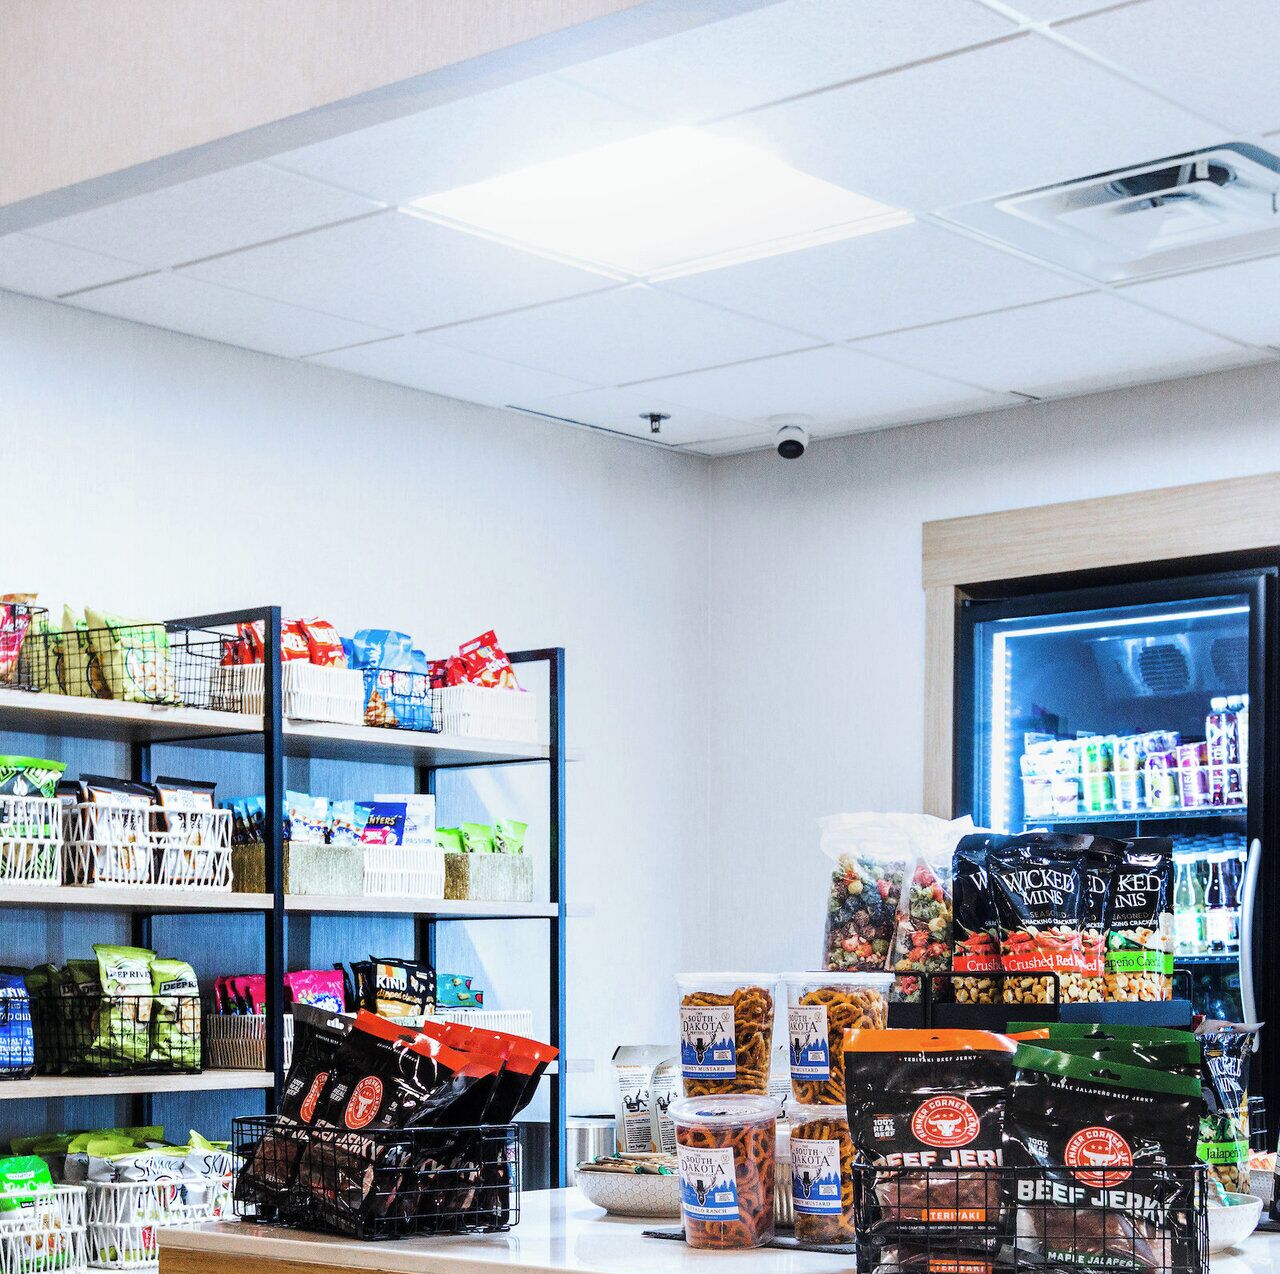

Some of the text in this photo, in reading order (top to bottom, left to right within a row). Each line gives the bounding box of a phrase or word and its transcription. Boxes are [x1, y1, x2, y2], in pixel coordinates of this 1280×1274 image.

[1001, 868, 1075, 894] WICKED
[1023, 890, 1064, 906] MINIS
[1010, 957, 1053, 970] Crushed
[376, 975, 407, 990] KIND
[683, 1021, 725, 1032] DAKOTA
[917, 1099, 967, 1138] RENNER CORNER
[682, 1160, 725, 1175] DAKOTA
[791, 1155, 830, 1167] DAKOTA
[1018, 1180, 1085, 1204] BEEF
[929, 1211, 980, 1220] TERIYAKI
